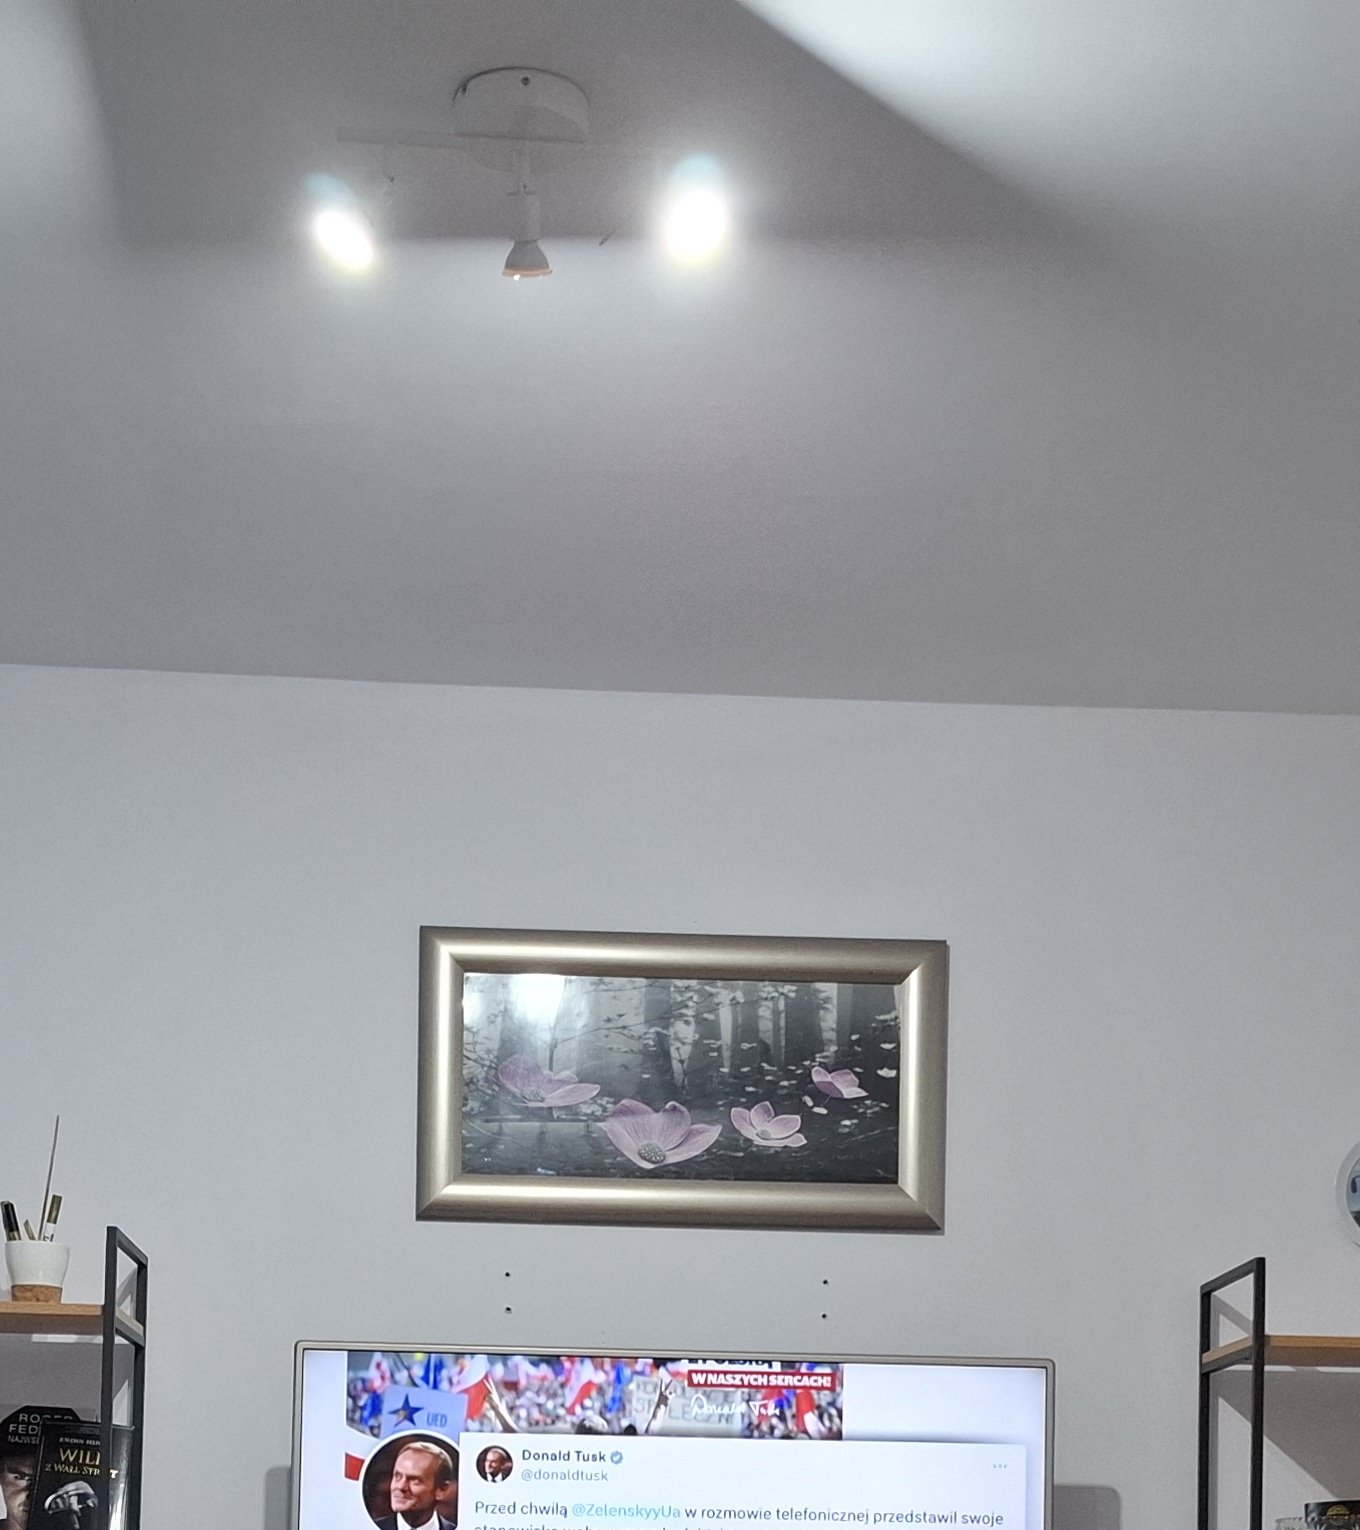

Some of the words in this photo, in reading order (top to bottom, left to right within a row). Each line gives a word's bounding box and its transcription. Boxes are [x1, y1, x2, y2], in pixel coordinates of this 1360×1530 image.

[707, 1373, 768, 1387] NASZYCH
[521, 1449, 571, 1463] Donald
[575, 1450, 607, 1463] Tusk
[54, 1463, 80, 1474] WALL
[521, 1468, 609, 1482] @donaldtusk
[474, 1501, 517, 1516] Przed
[571, 1503, 681, 1520] @ZelenskyyUa
[684, 1508, 698, 1519] w
[701, 1507, 772, 1520] rozmowie
[776, 1507, 869, 1524] telefonicznej
[961, 1511, 1004, 1527] swoje
